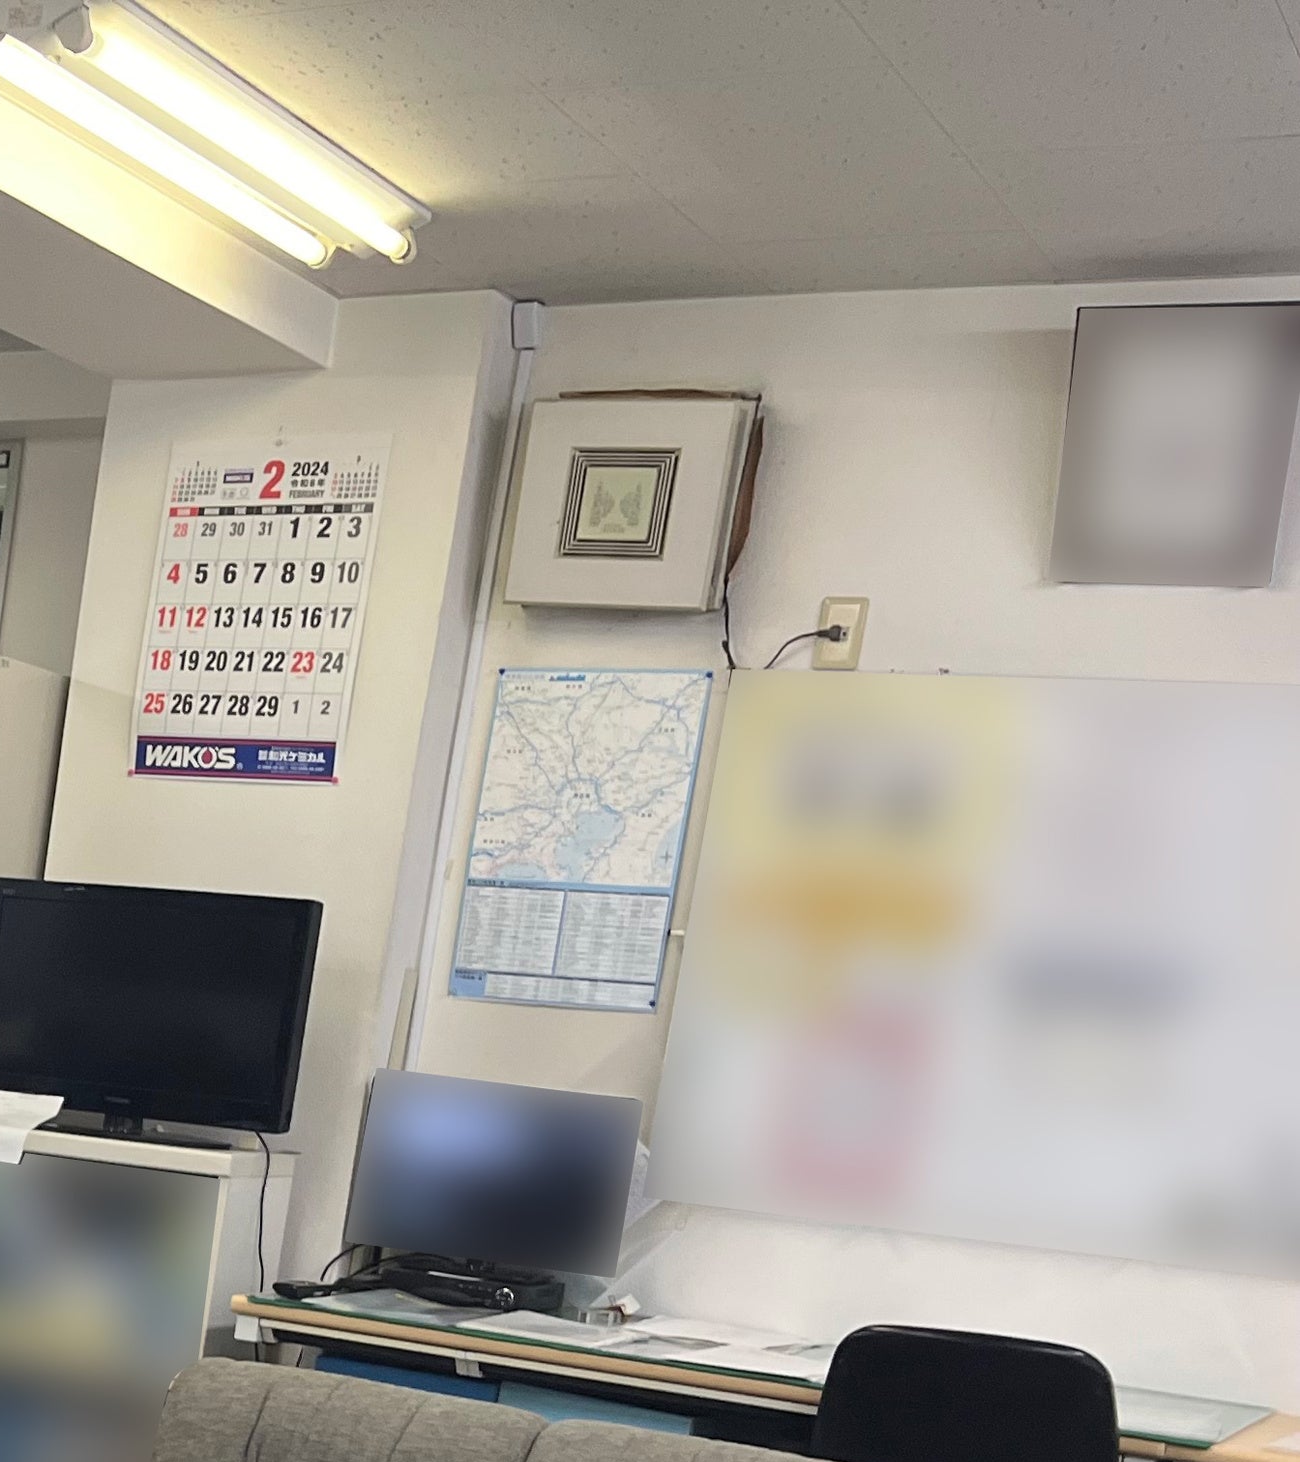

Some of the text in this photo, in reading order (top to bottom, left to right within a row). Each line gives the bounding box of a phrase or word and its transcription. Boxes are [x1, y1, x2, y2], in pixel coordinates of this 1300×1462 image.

[259, 459, 286, 499] 2
[292, 461, 329, 477] 2024
[289, 489, 325, 498] FEBRUARY
[173, 517, 361, 538] 28 29 30 31 1 2 3
[167, 562, 359, 584] 4 5 6 7 8 9 10
[159, 607, 352, 628] 11 12 13 14 15 16 17
[152, 650, 344, 673] 18 19 20 21 22 23 24
[143, 693, 330, 717] 25 26 27 28 29 1 2
